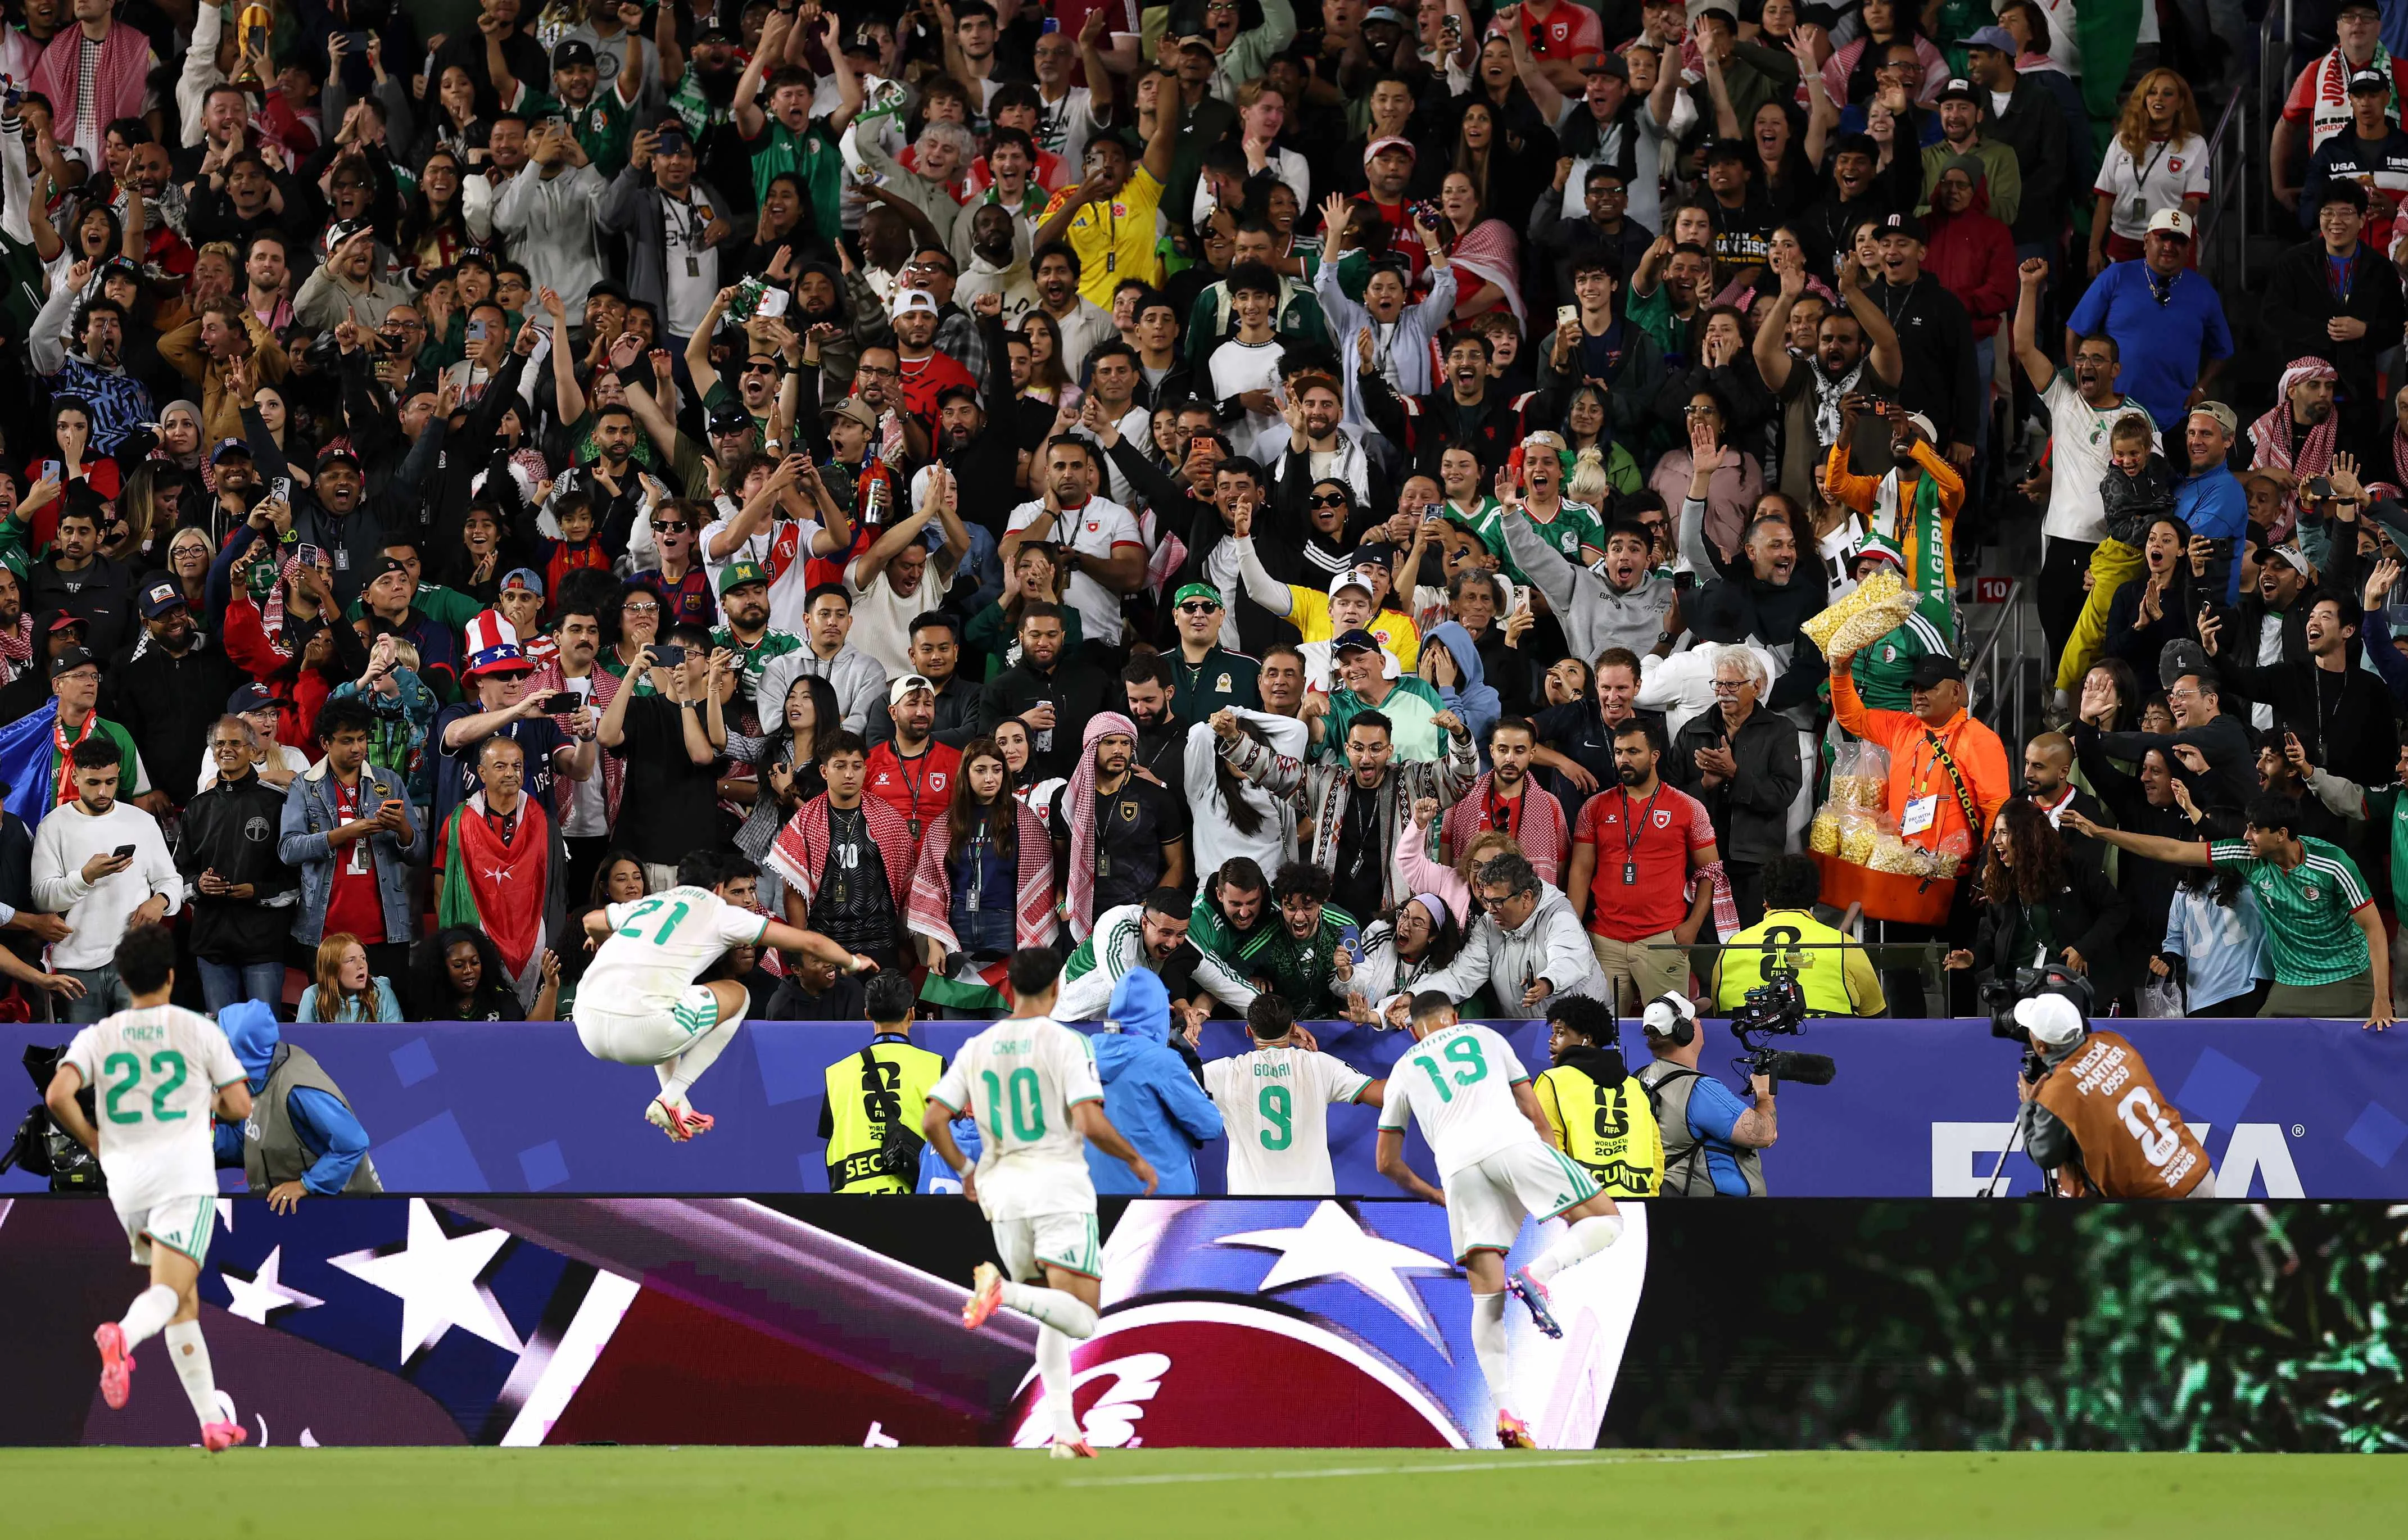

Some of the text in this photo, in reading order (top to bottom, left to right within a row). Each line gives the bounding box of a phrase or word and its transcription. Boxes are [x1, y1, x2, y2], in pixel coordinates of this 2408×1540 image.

[2330, 161, 2357, 172] USA
[1930, 505, 1945, 604] ALGERIA
[735, 565, 753, 580] M
[1983, 581, 2007, 598] 10
[838, 843, 858, 868] 10
[619, 899, 689, 945] 21
[122, 1026, 164, 1041] MAZA
[1768, 1014, 1781, 1024] HOLD
[1413, 1035, 1488, 1103] 19
[2069, 1041, 2111, 1080] MEDIA
[2076, 1045, 2127, 1097] PARTNER
[105, 1051, 187, 1124] 22
[2099, 1065, 2130, 1097] 0959
[981, 1067, 1047, 1142] 10
[1259, 1085, 1292, 1151] 9
[1594, 1138, 1617, 1147] WORLD
[1604, 1125, 1621, 1134] FIFA
[2156, 1139, 2172, 1157] FIFA
[2165, 1152, 2197, 1189] 2026
